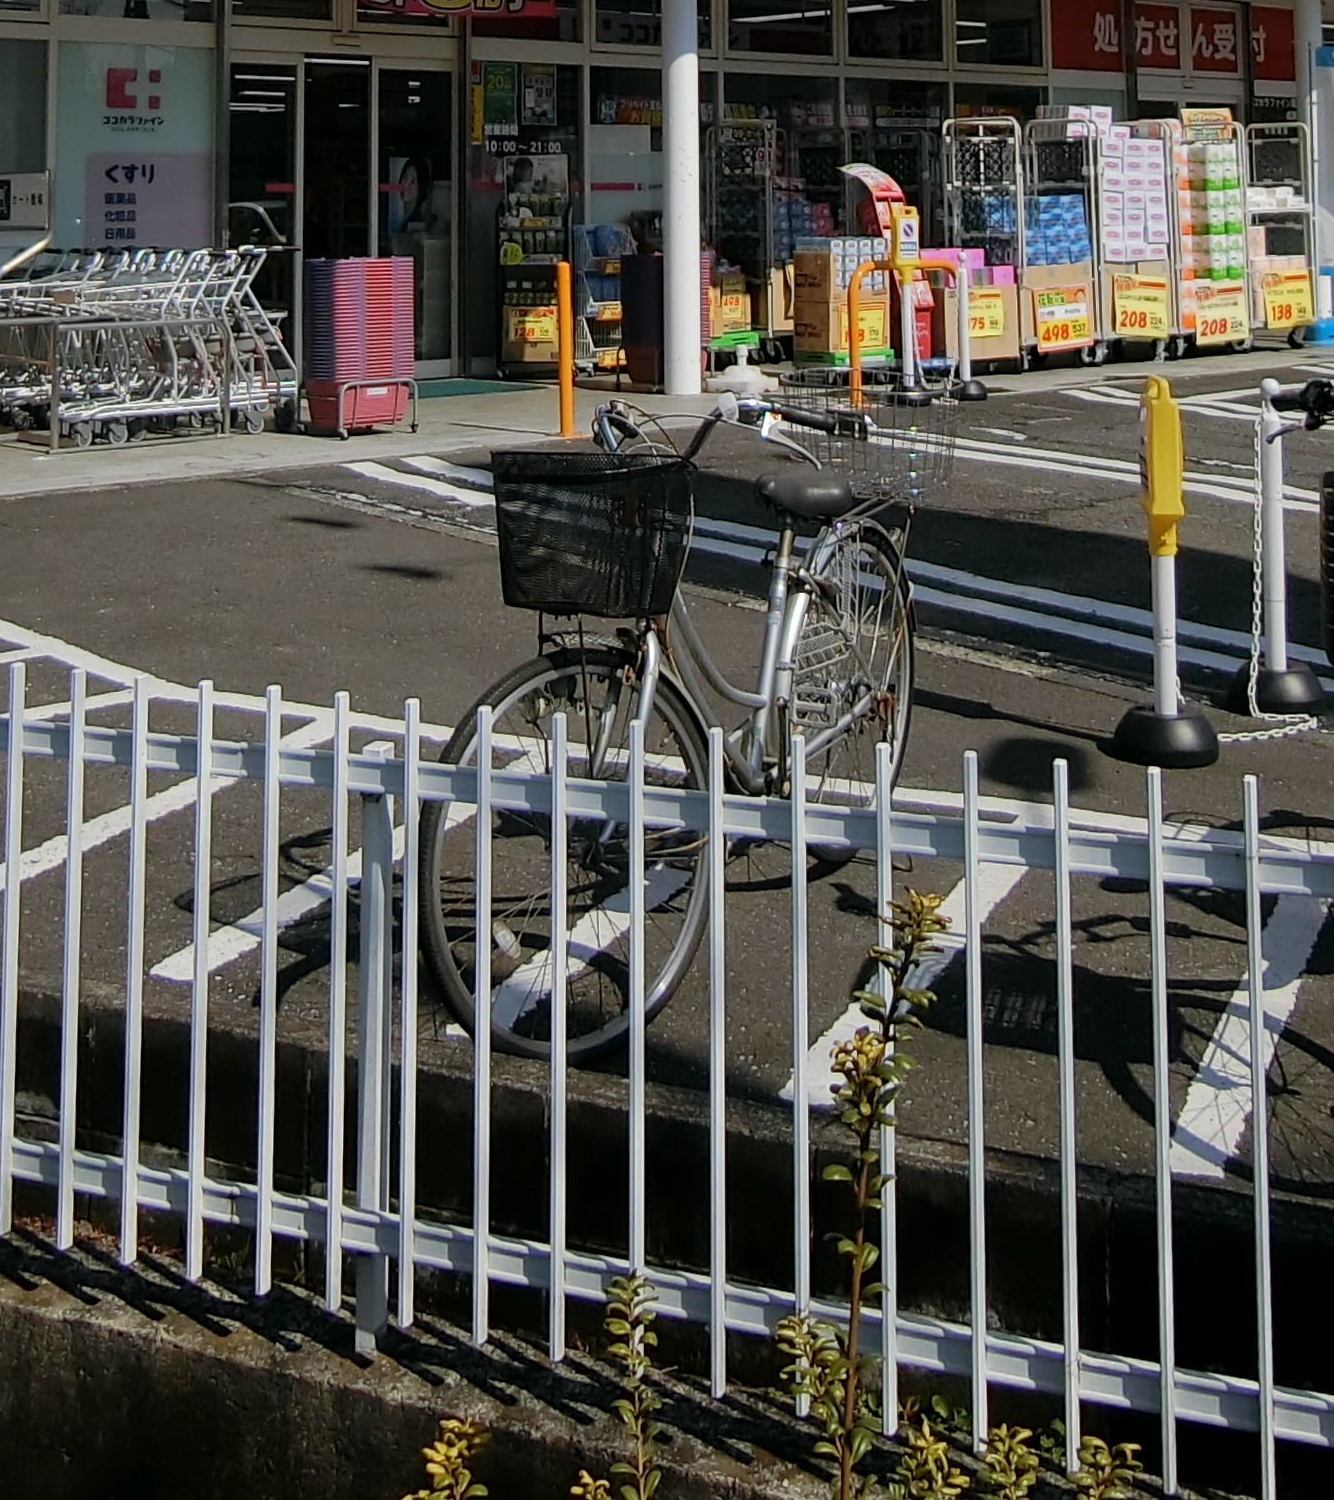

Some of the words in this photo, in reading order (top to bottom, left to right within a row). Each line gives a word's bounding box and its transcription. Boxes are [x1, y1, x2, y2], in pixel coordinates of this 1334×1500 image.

[103, 116, 164, 126] ココカラファイン
[105, 164, 155, 184] くすり
[104, 209, 137, 222] 化粧品
[104, 227, 137, 240] 日用品
[1120, 309, 1147, 328] 208
[1271, 303, 1293, 322] 138
[968, 316, 986, 331] 75
[1072, 322, 1086, 333] 537
[1200, 318, 1227, 337] 208
[514, 327, 535, 338] 128
[844, 328, 865, 343] 18
[1041, 323, 1070, 342] 498
